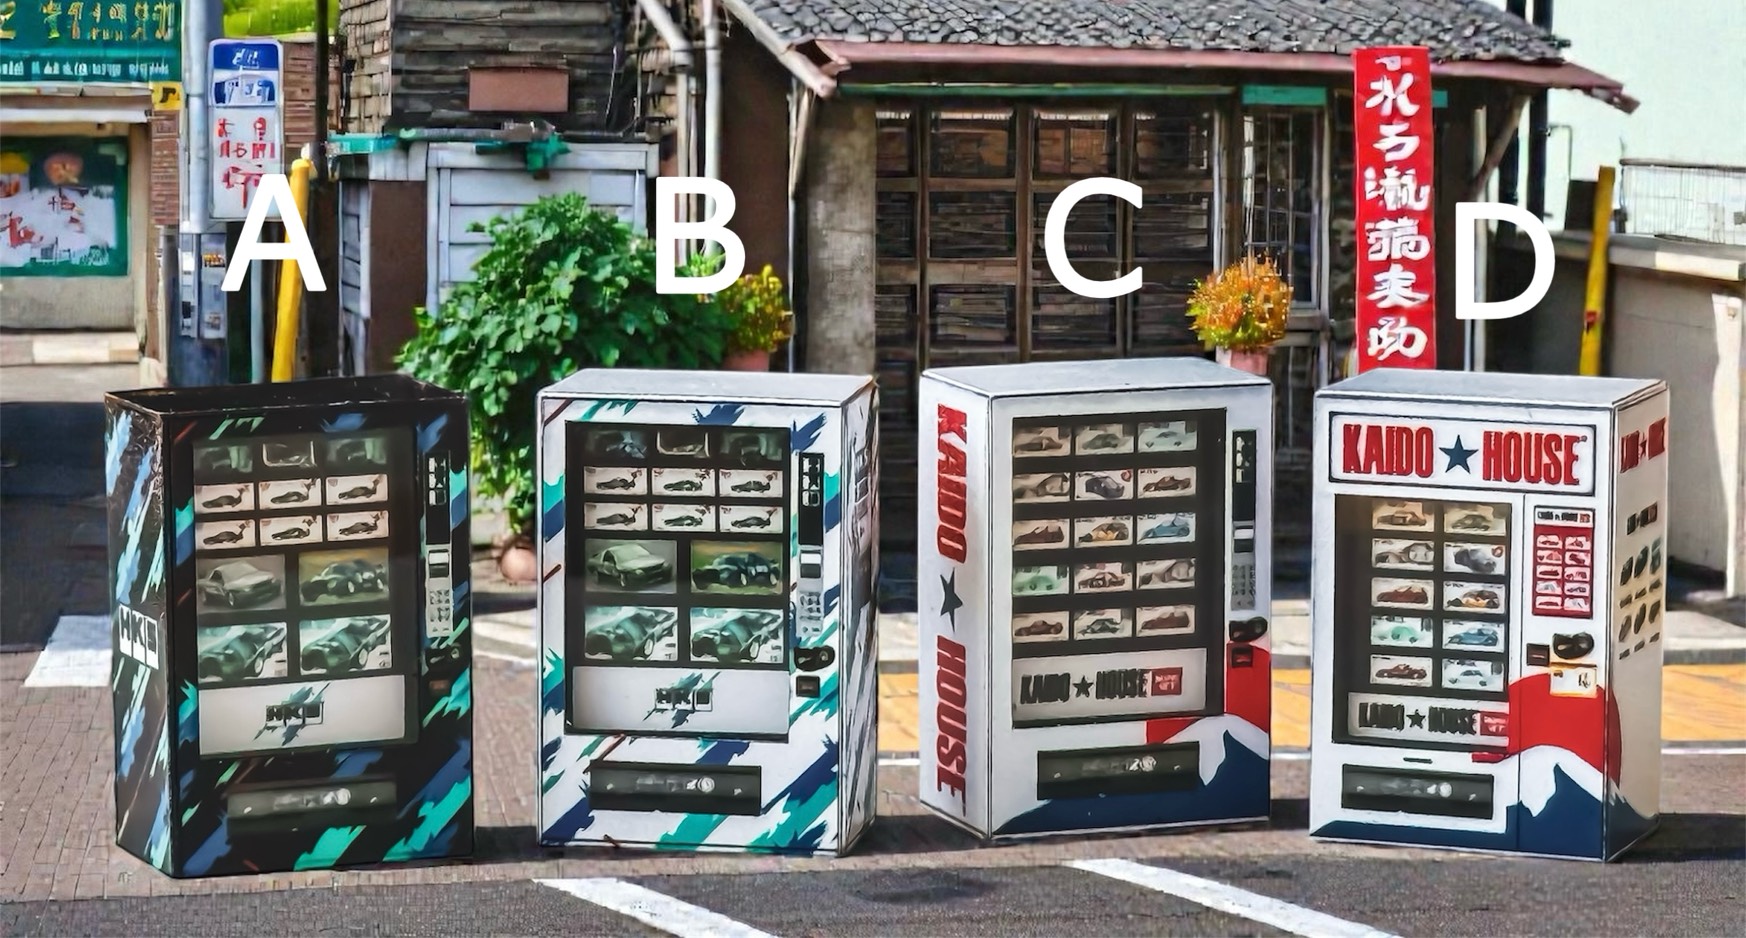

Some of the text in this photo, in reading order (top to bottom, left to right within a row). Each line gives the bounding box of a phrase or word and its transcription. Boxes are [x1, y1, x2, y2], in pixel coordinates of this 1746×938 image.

[1342, 423, 1434, 478] KAIDO
[1482, 430, 1580, 486] HOUSE
[937, 403, 967, 818] KAIDO HOUSE
[265, 702, 322, 723] HK
